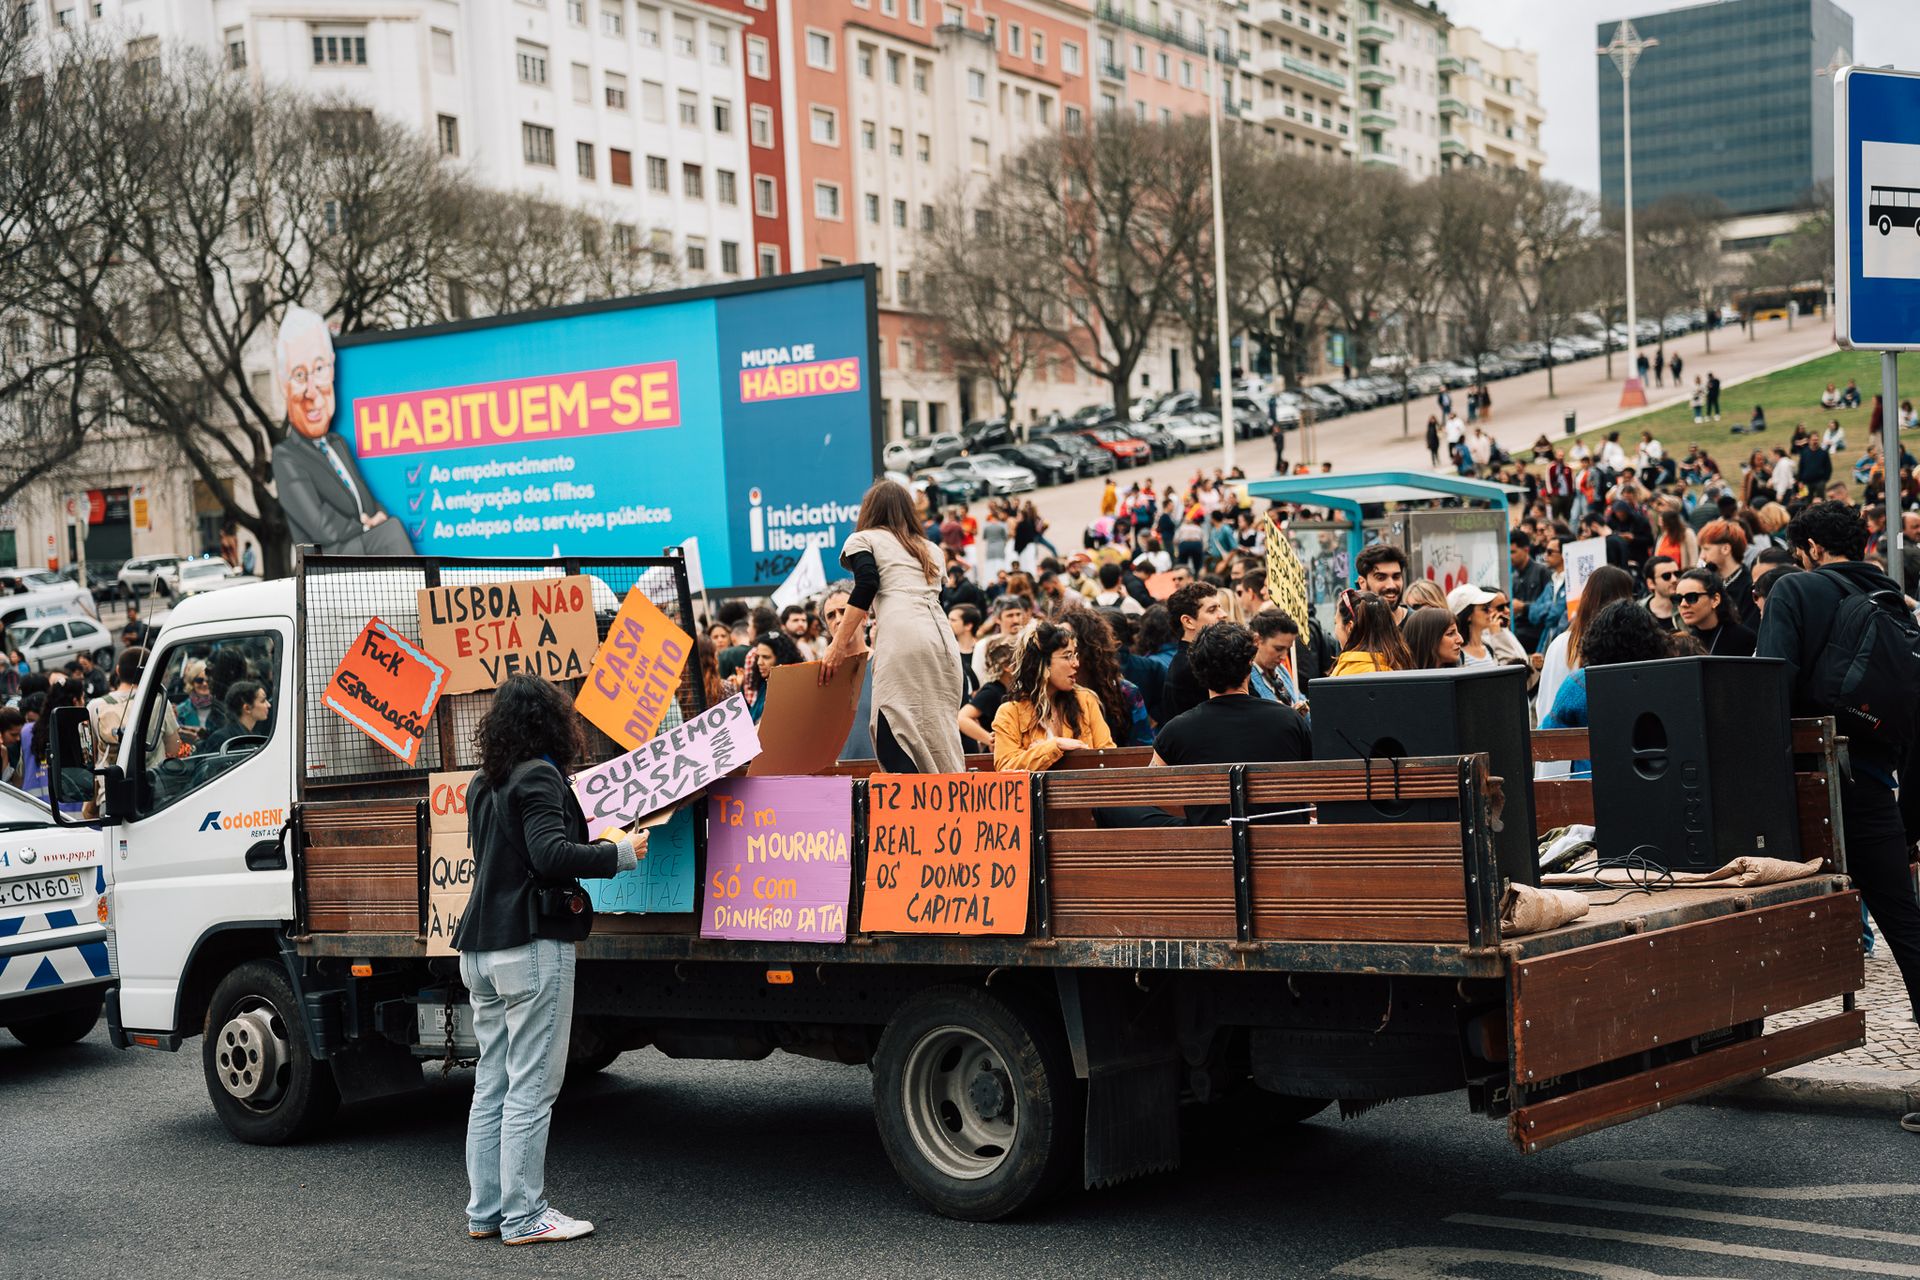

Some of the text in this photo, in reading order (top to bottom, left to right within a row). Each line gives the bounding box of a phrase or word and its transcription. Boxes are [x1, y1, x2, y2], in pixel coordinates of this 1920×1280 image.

[741, 343, 815, 367] MUDA DE
[743, 361, 858, 399] HÁBITOS
[359, 371, 672, 451] HABITUEM-SE
[429, 455, 575, 484] Ao empobrecimento
[431, 482, 595, 513] À emigração dos filhos
[433, 505, 672, 539] Ao colapso dos serviços públicos
[768, 525, 836, 551] liberal
[429, 580, 584, 624] LISBOA NÃO
[455, 613, 557, 657] ESTÁ À
[479, 648, 582, 684] VENDA
[594, 616, 645, 701] CASA
[634, 655, 650, 680] UM
[623, 639, 683, 744] DIREITO
[585, 696, 743, 795] QUEREMOS
[709, 727, 736, 758] PARA
[592, 754, 701, 819] CASA
[615, 754, 736, 821] VIVER
[871, 775, 1025, 813] T2 NO PRÍNCIPE
[713, 795, 744, 827] T2
[754, 807, 777, 827] na
[250, 829, 266, 838] RENT
[873, 817, 1021, 856] REAL SÓ PARA
[44, 849, 95, 863] www.psp.pt
[876, 860, 1017, 889] OS DONOS DO
[601, 881, 683, 906] CAPITAL
[906, 892, 994, 926] CAPITAL
[796, 907, 816, 932] DA
